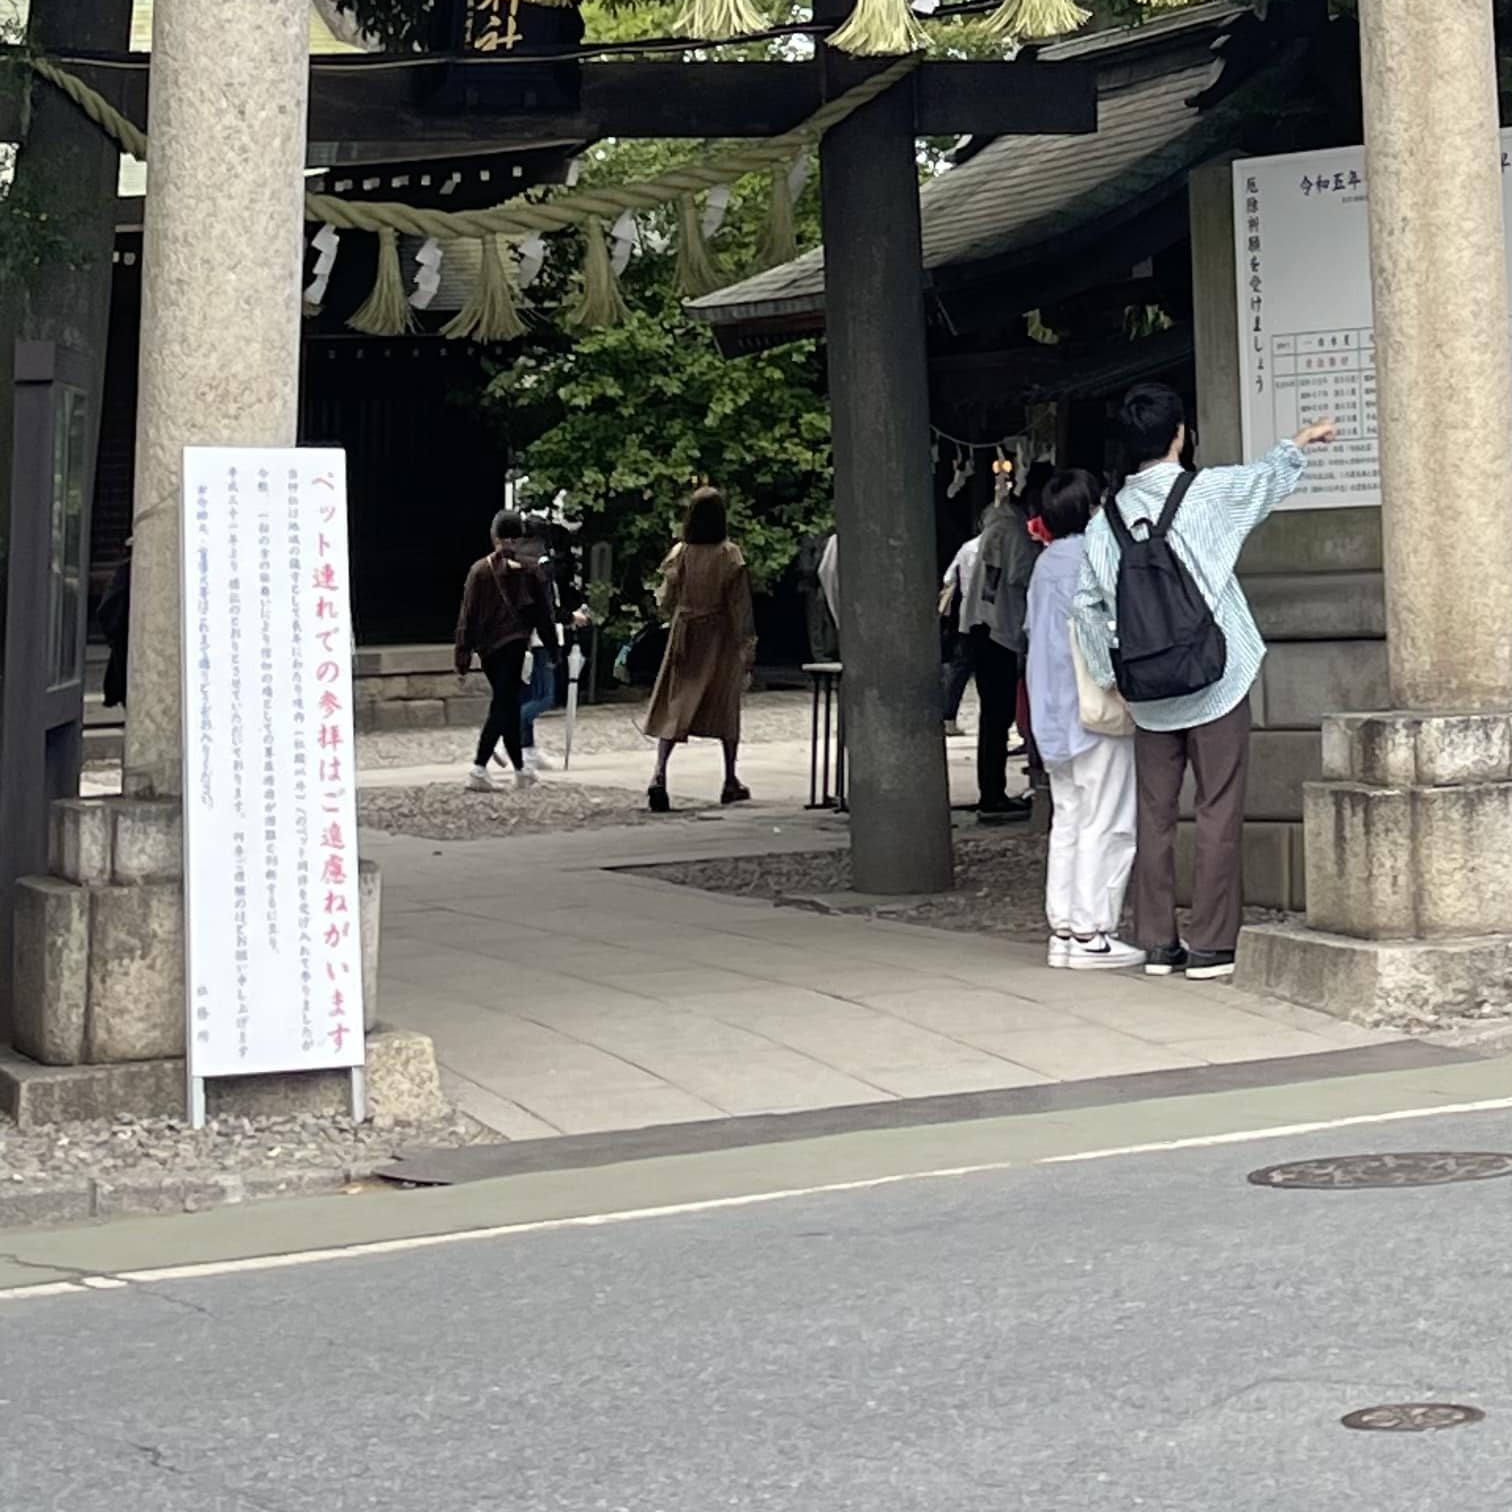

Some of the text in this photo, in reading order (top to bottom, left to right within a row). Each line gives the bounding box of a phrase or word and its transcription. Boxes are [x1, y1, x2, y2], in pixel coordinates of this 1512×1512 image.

[1246, 176, 1264, 394] 厄除祈願を受けましょう
[1300, 170, 1361, 196] 令和五年
[312, 471, 350, 1054] ペット連れでの参拝はご遠慮ねがいます
